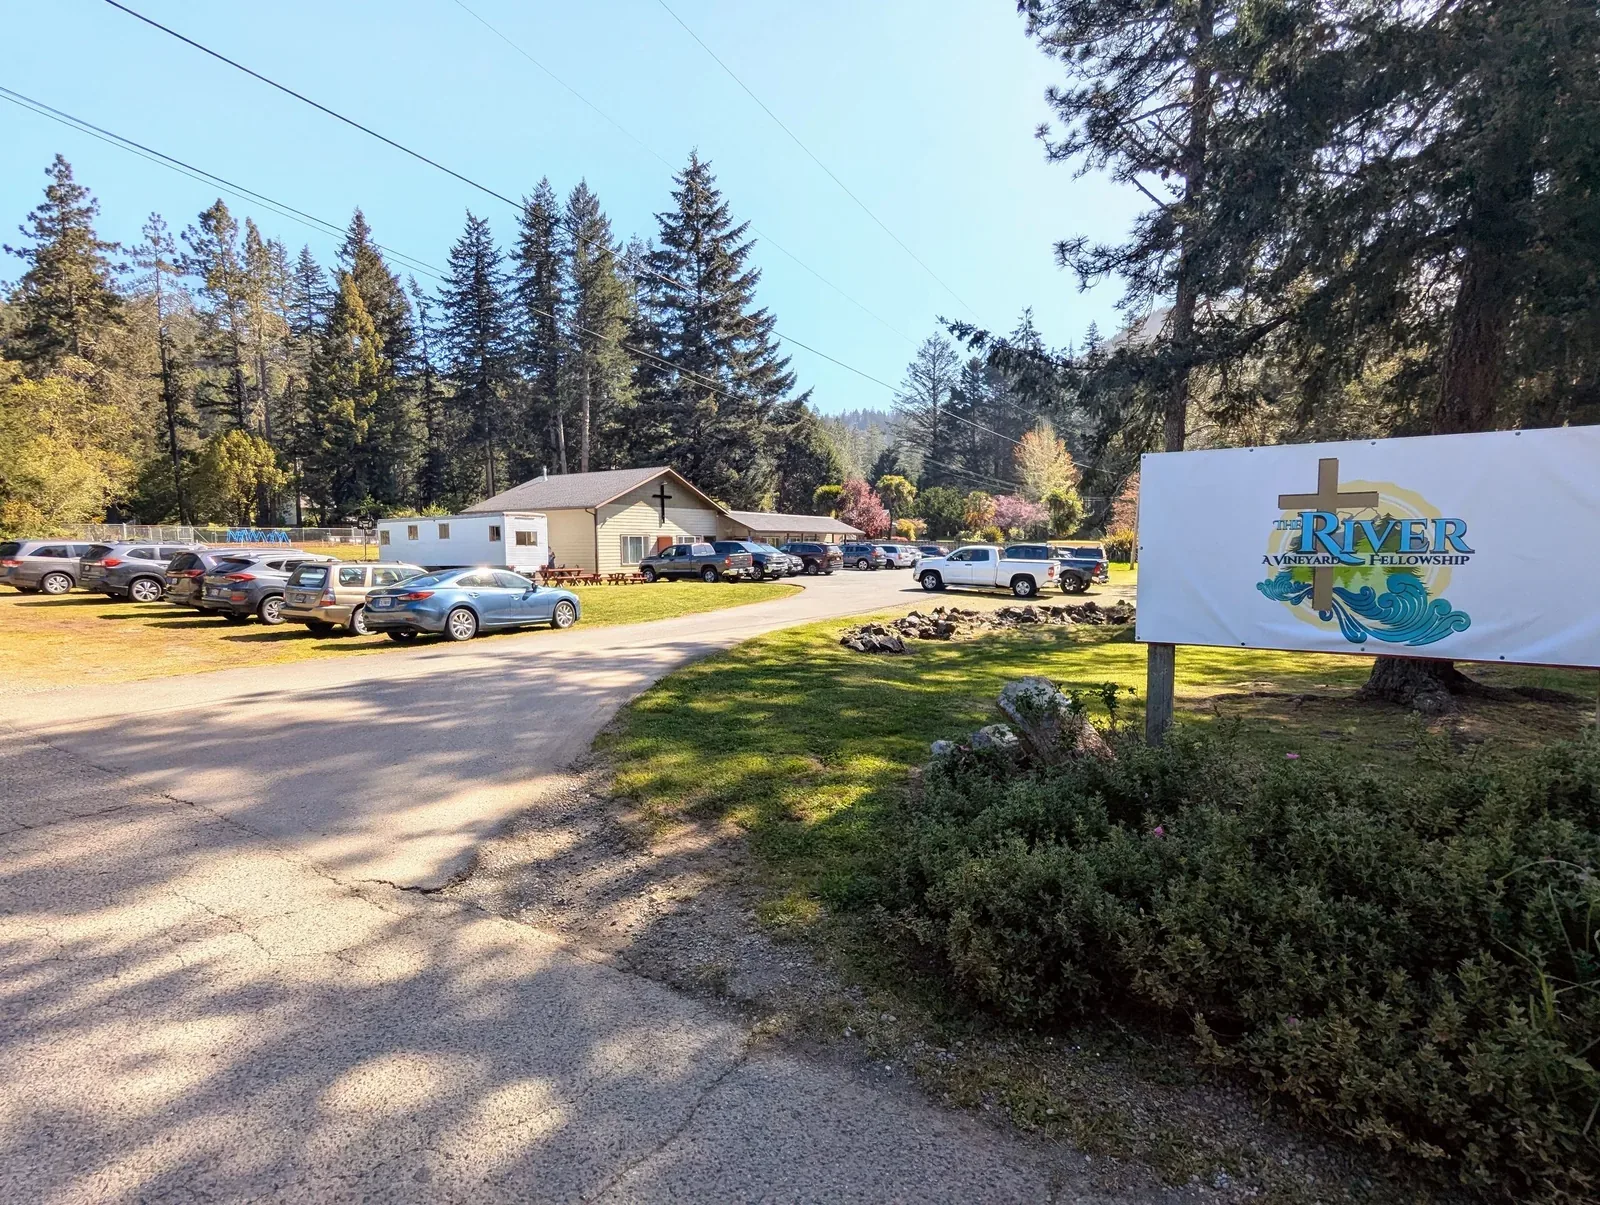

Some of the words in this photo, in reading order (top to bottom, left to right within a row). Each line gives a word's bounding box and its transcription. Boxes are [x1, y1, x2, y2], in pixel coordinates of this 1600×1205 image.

[1273, 519, 1301, 530] THE
[1296, 511, 1475, 565] RIVER
[1262, 555, 1272, 566] A
[1274, 553, 1341, 565] VINEYARD
[1369, 554, 1470, 565] FELLOWSHIP
